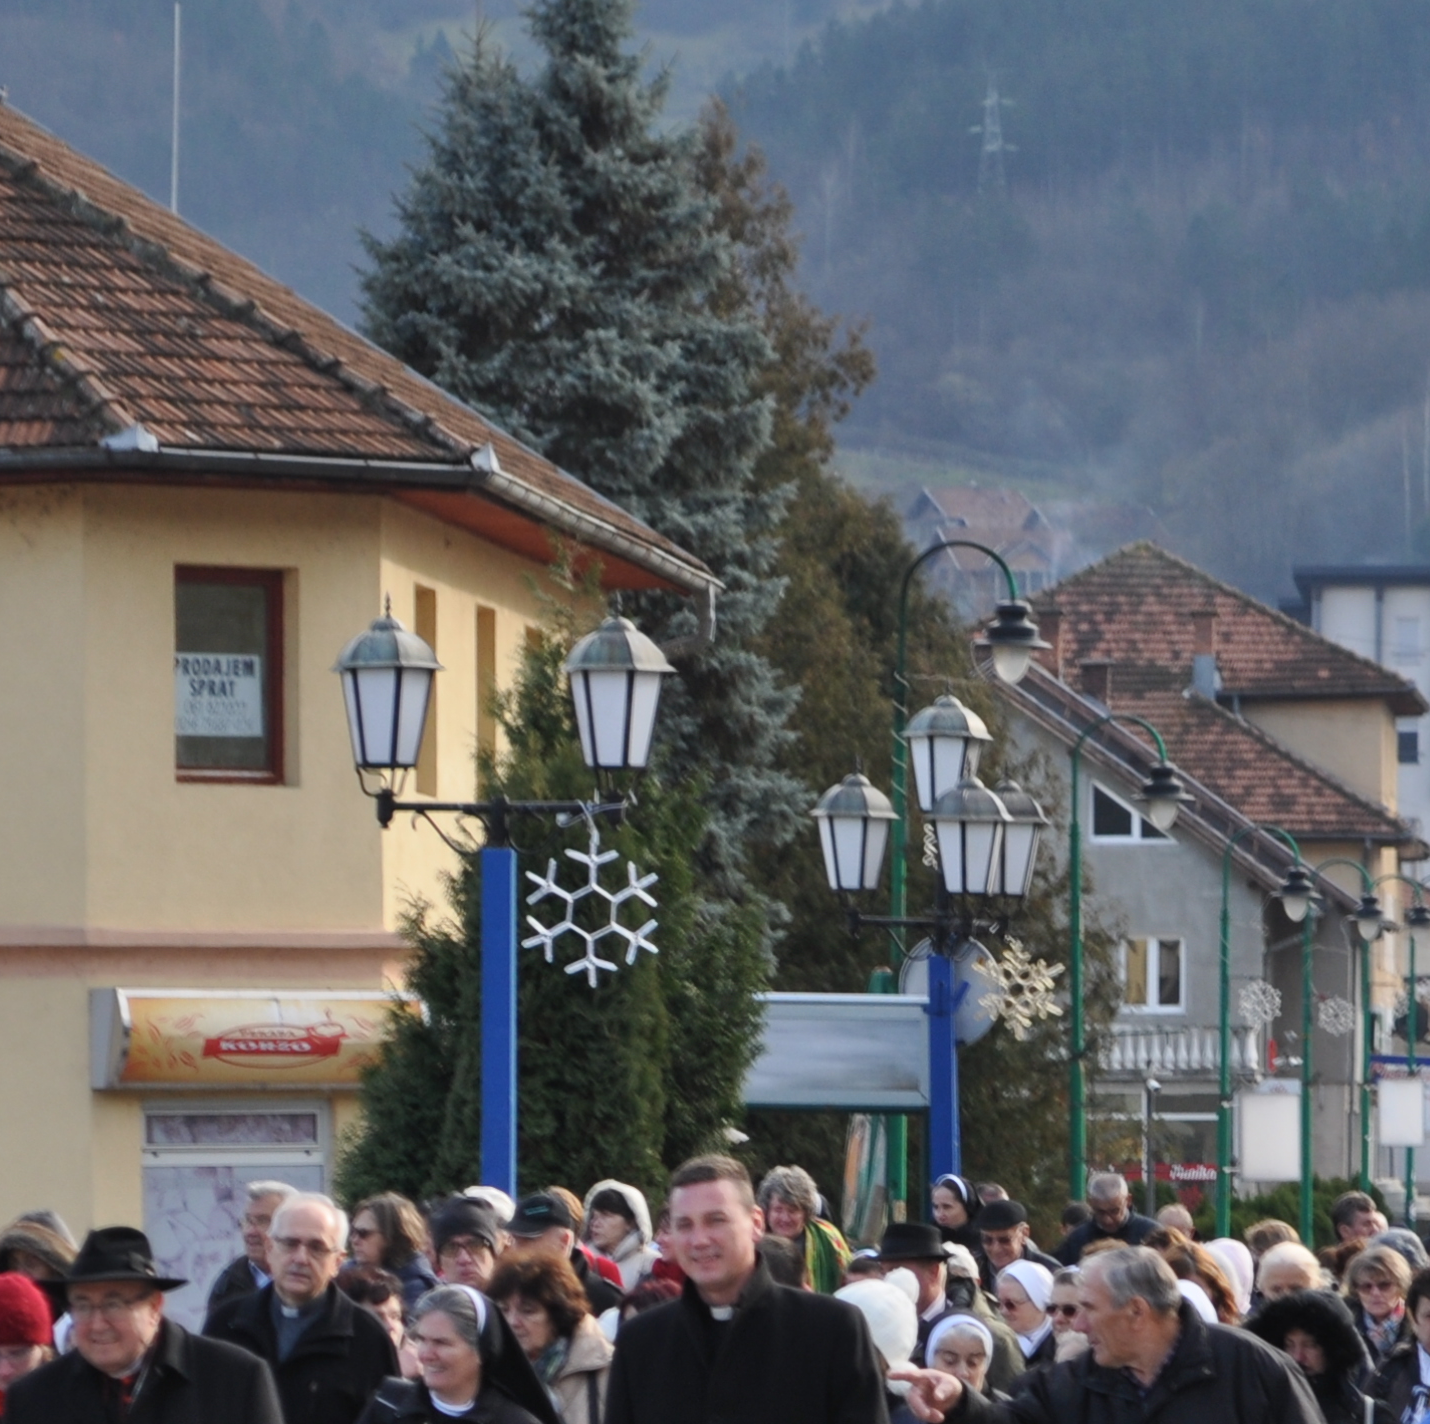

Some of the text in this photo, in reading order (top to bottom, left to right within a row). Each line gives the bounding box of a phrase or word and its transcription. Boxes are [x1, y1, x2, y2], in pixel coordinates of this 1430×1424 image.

[174, 657, 255, 677] PRODAJEM
[189, 679, 236, 697] SPRAT
[219, 1040, 312, 1052] KORZO
